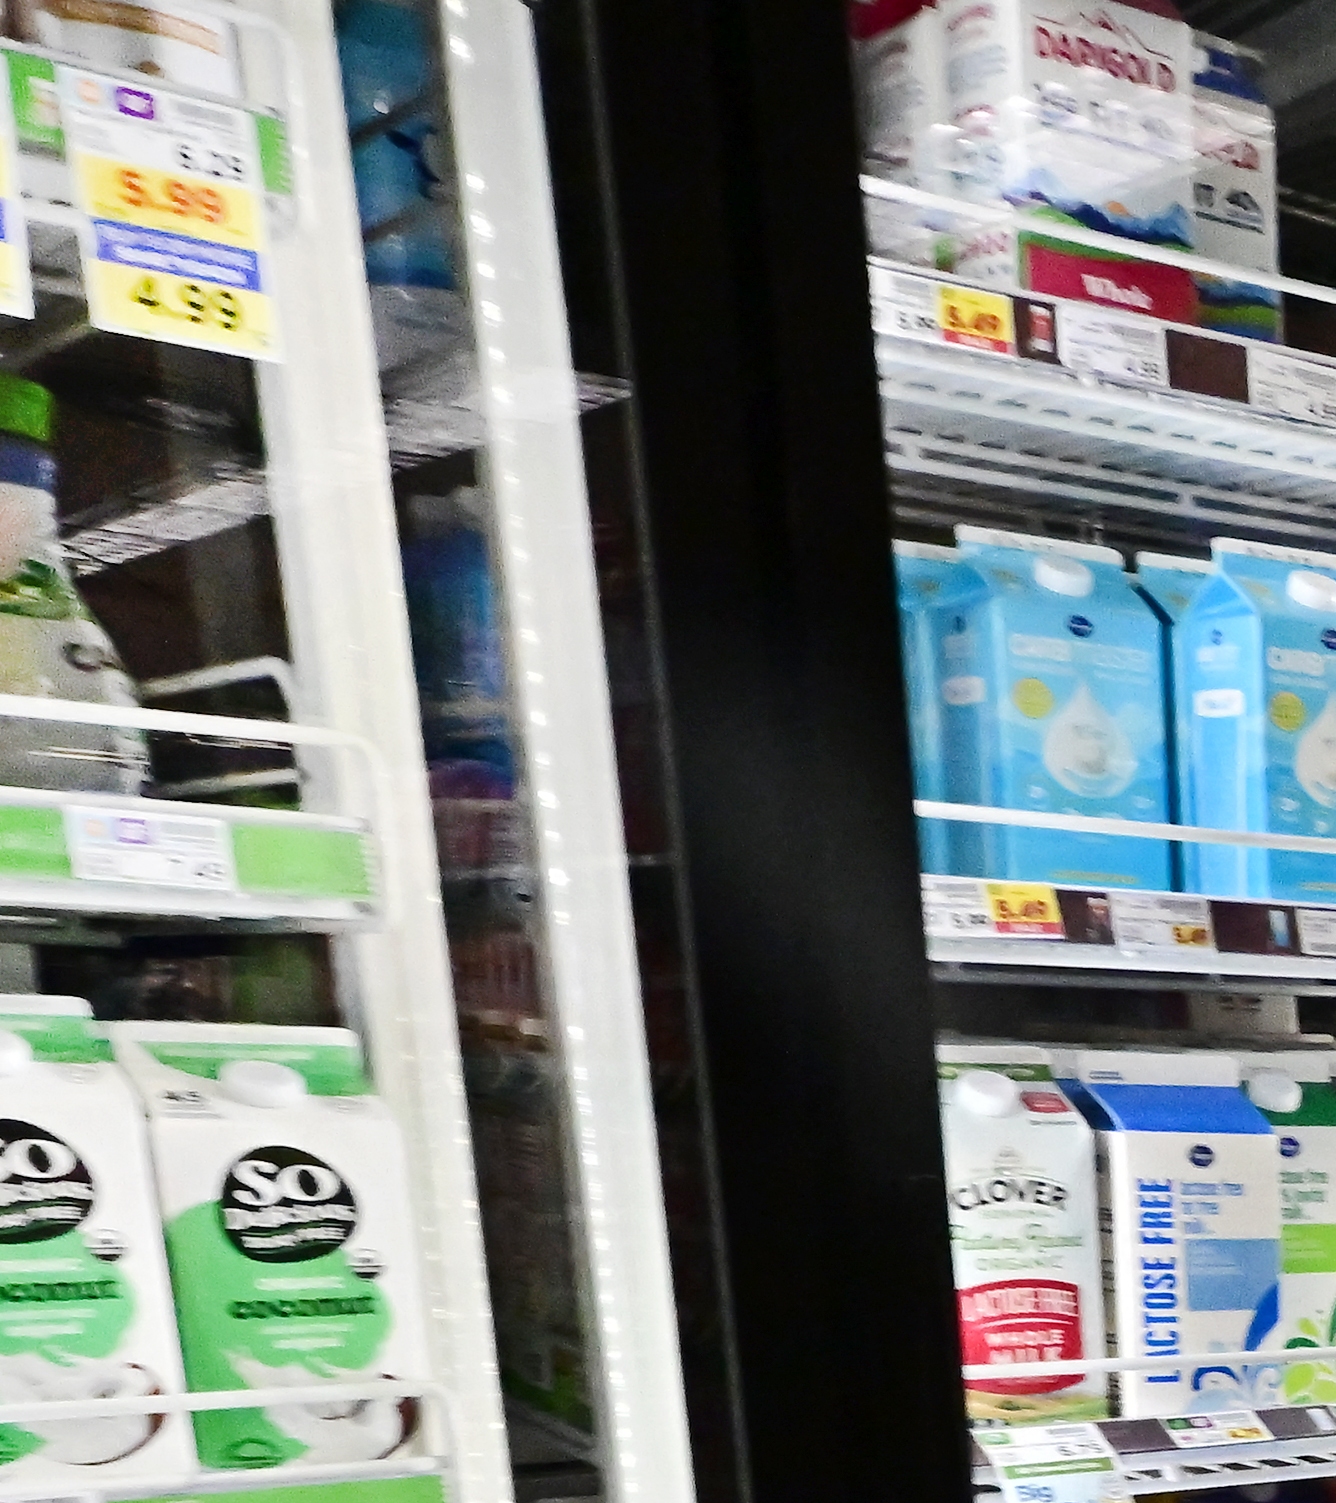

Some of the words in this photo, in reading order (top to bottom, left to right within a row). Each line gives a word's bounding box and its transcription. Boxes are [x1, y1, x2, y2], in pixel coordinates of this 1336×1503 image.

[120, 168, 225, 224] 5.99
[129, 276, 240, 332] 4.99
[231, 1160, 342, 1207] SO
[951, 1178, 1069, 1211] CLOVER
[1136, 1178, 1175, 1246] FREE
